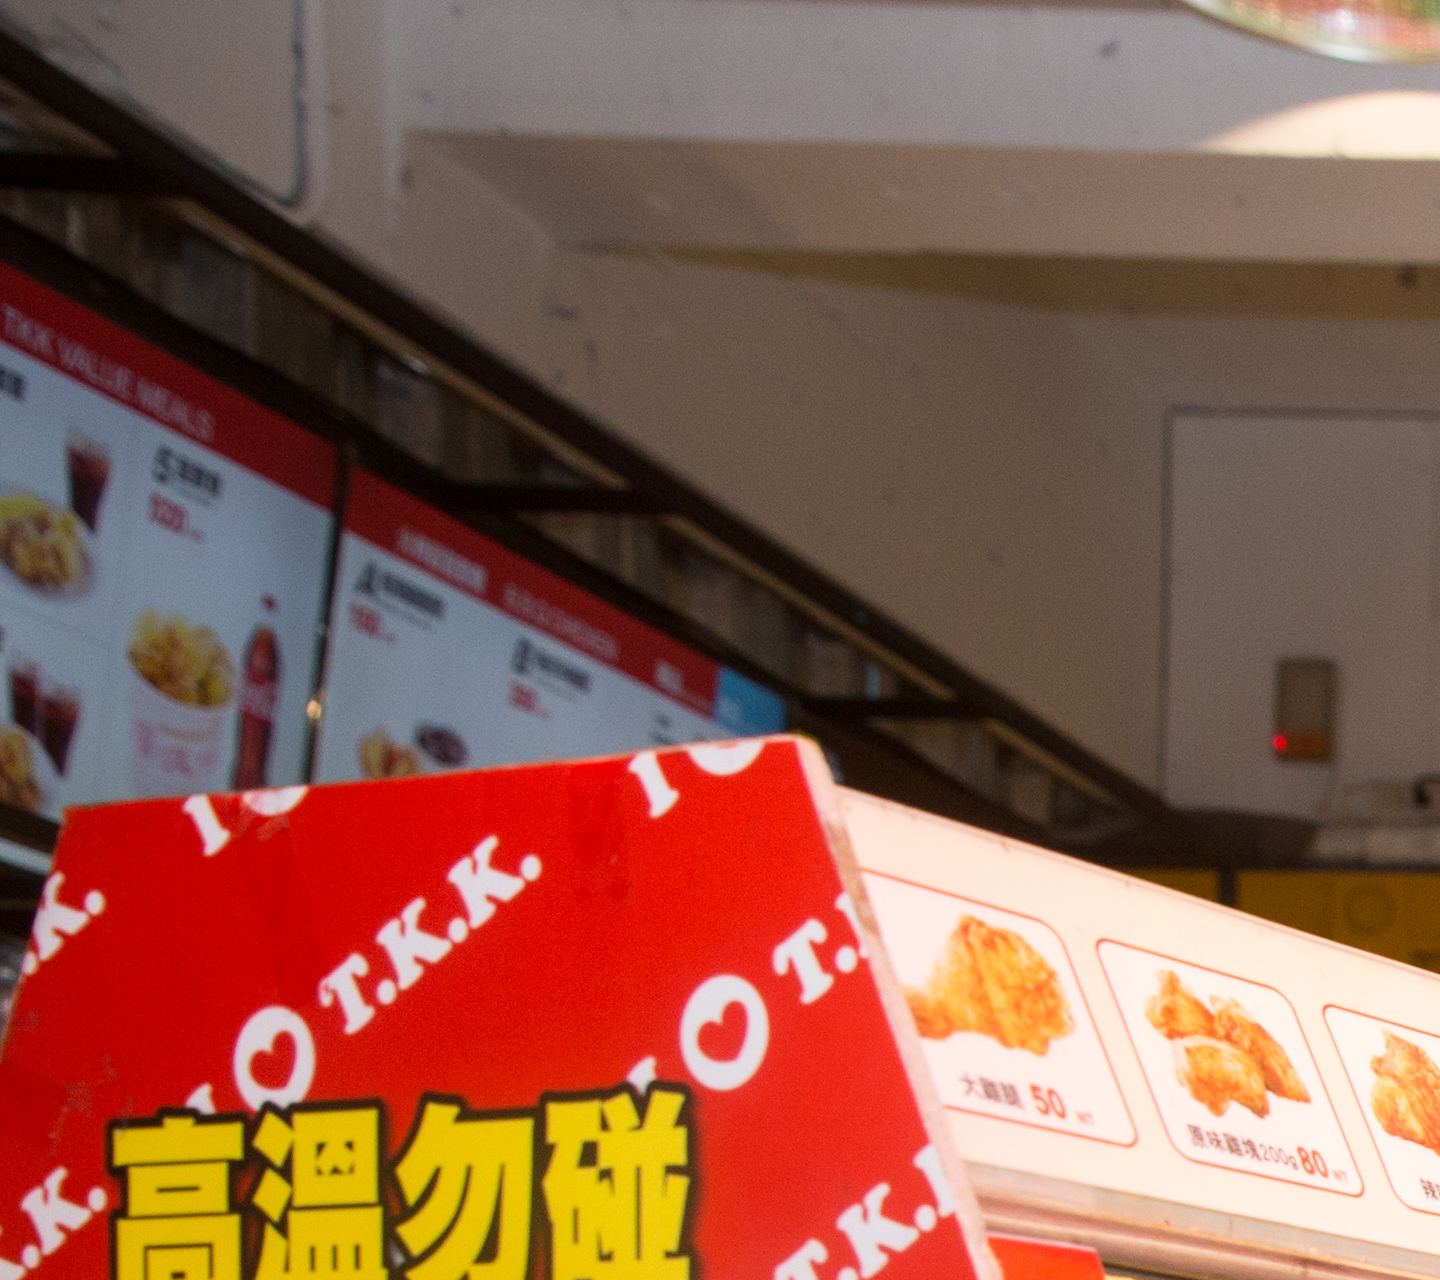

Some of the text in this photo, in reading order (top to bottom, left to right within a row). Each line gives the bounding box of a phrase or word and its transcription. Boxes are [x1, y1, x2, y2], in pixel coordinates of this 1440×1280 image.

[319, 836, 543, 1035] T.K.K.
[1028, 1083, 1066, 1120] 50
[1296, 1145, 1329, 1179] 80
